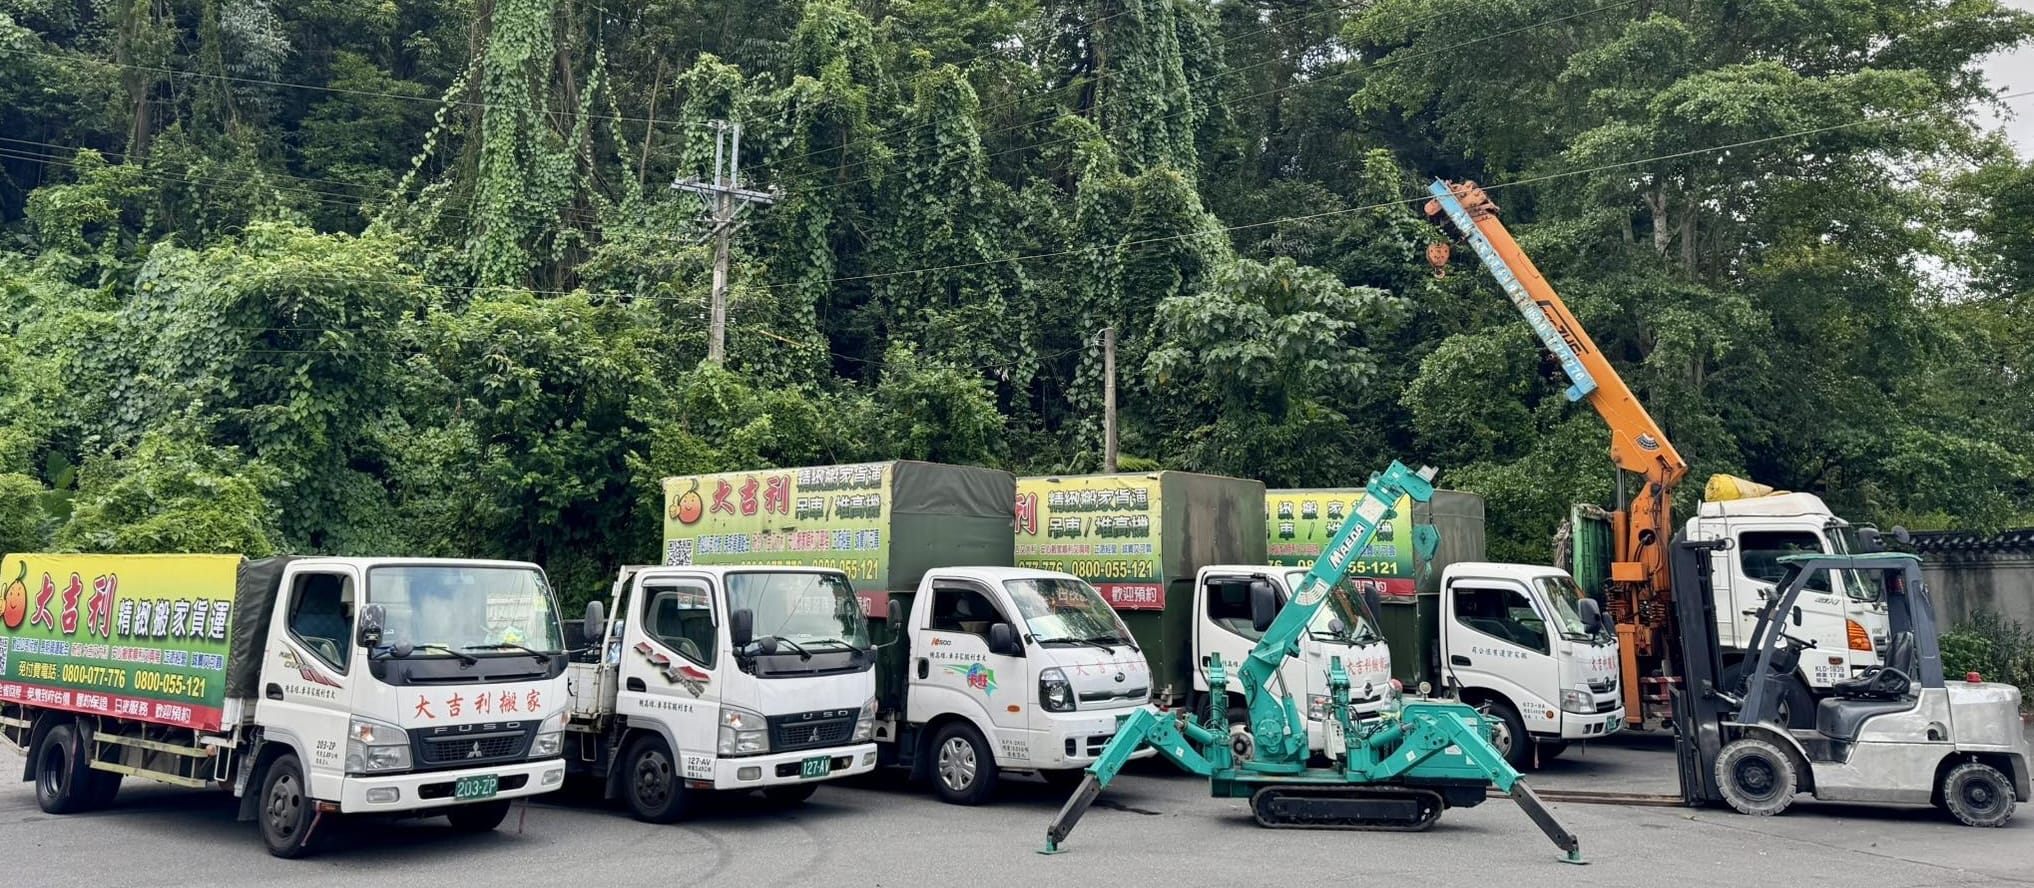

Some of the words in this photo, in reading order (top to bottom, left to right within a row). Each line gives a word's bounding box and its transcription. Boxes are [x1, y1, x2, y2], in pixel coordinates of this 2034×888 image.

[710, 475, 791, 516] 大吉利
[1048, 488, 1149, 513] 精緻搬家貨運
[1329, 522, 1367, 569] MAEDA
[1072, 561, 1153, 578] 0800-055-121
[31, 571, 117, 638] 大吉利
[117, 598, 231, 640] 精緻搬家貨運
[1112, 586, 1157, 602] 歡迎預約
[62, 663, 126, 688] 0800-077-776
[134, 670, 206, 697] 0800-055-121
[414, 688, 541, 719] 大吉利搬家
[434, 721, 521, 735] FUSO
[803, 759, 831, 776] 127-AV
[457, 778, 497, 797] 203-ZP
